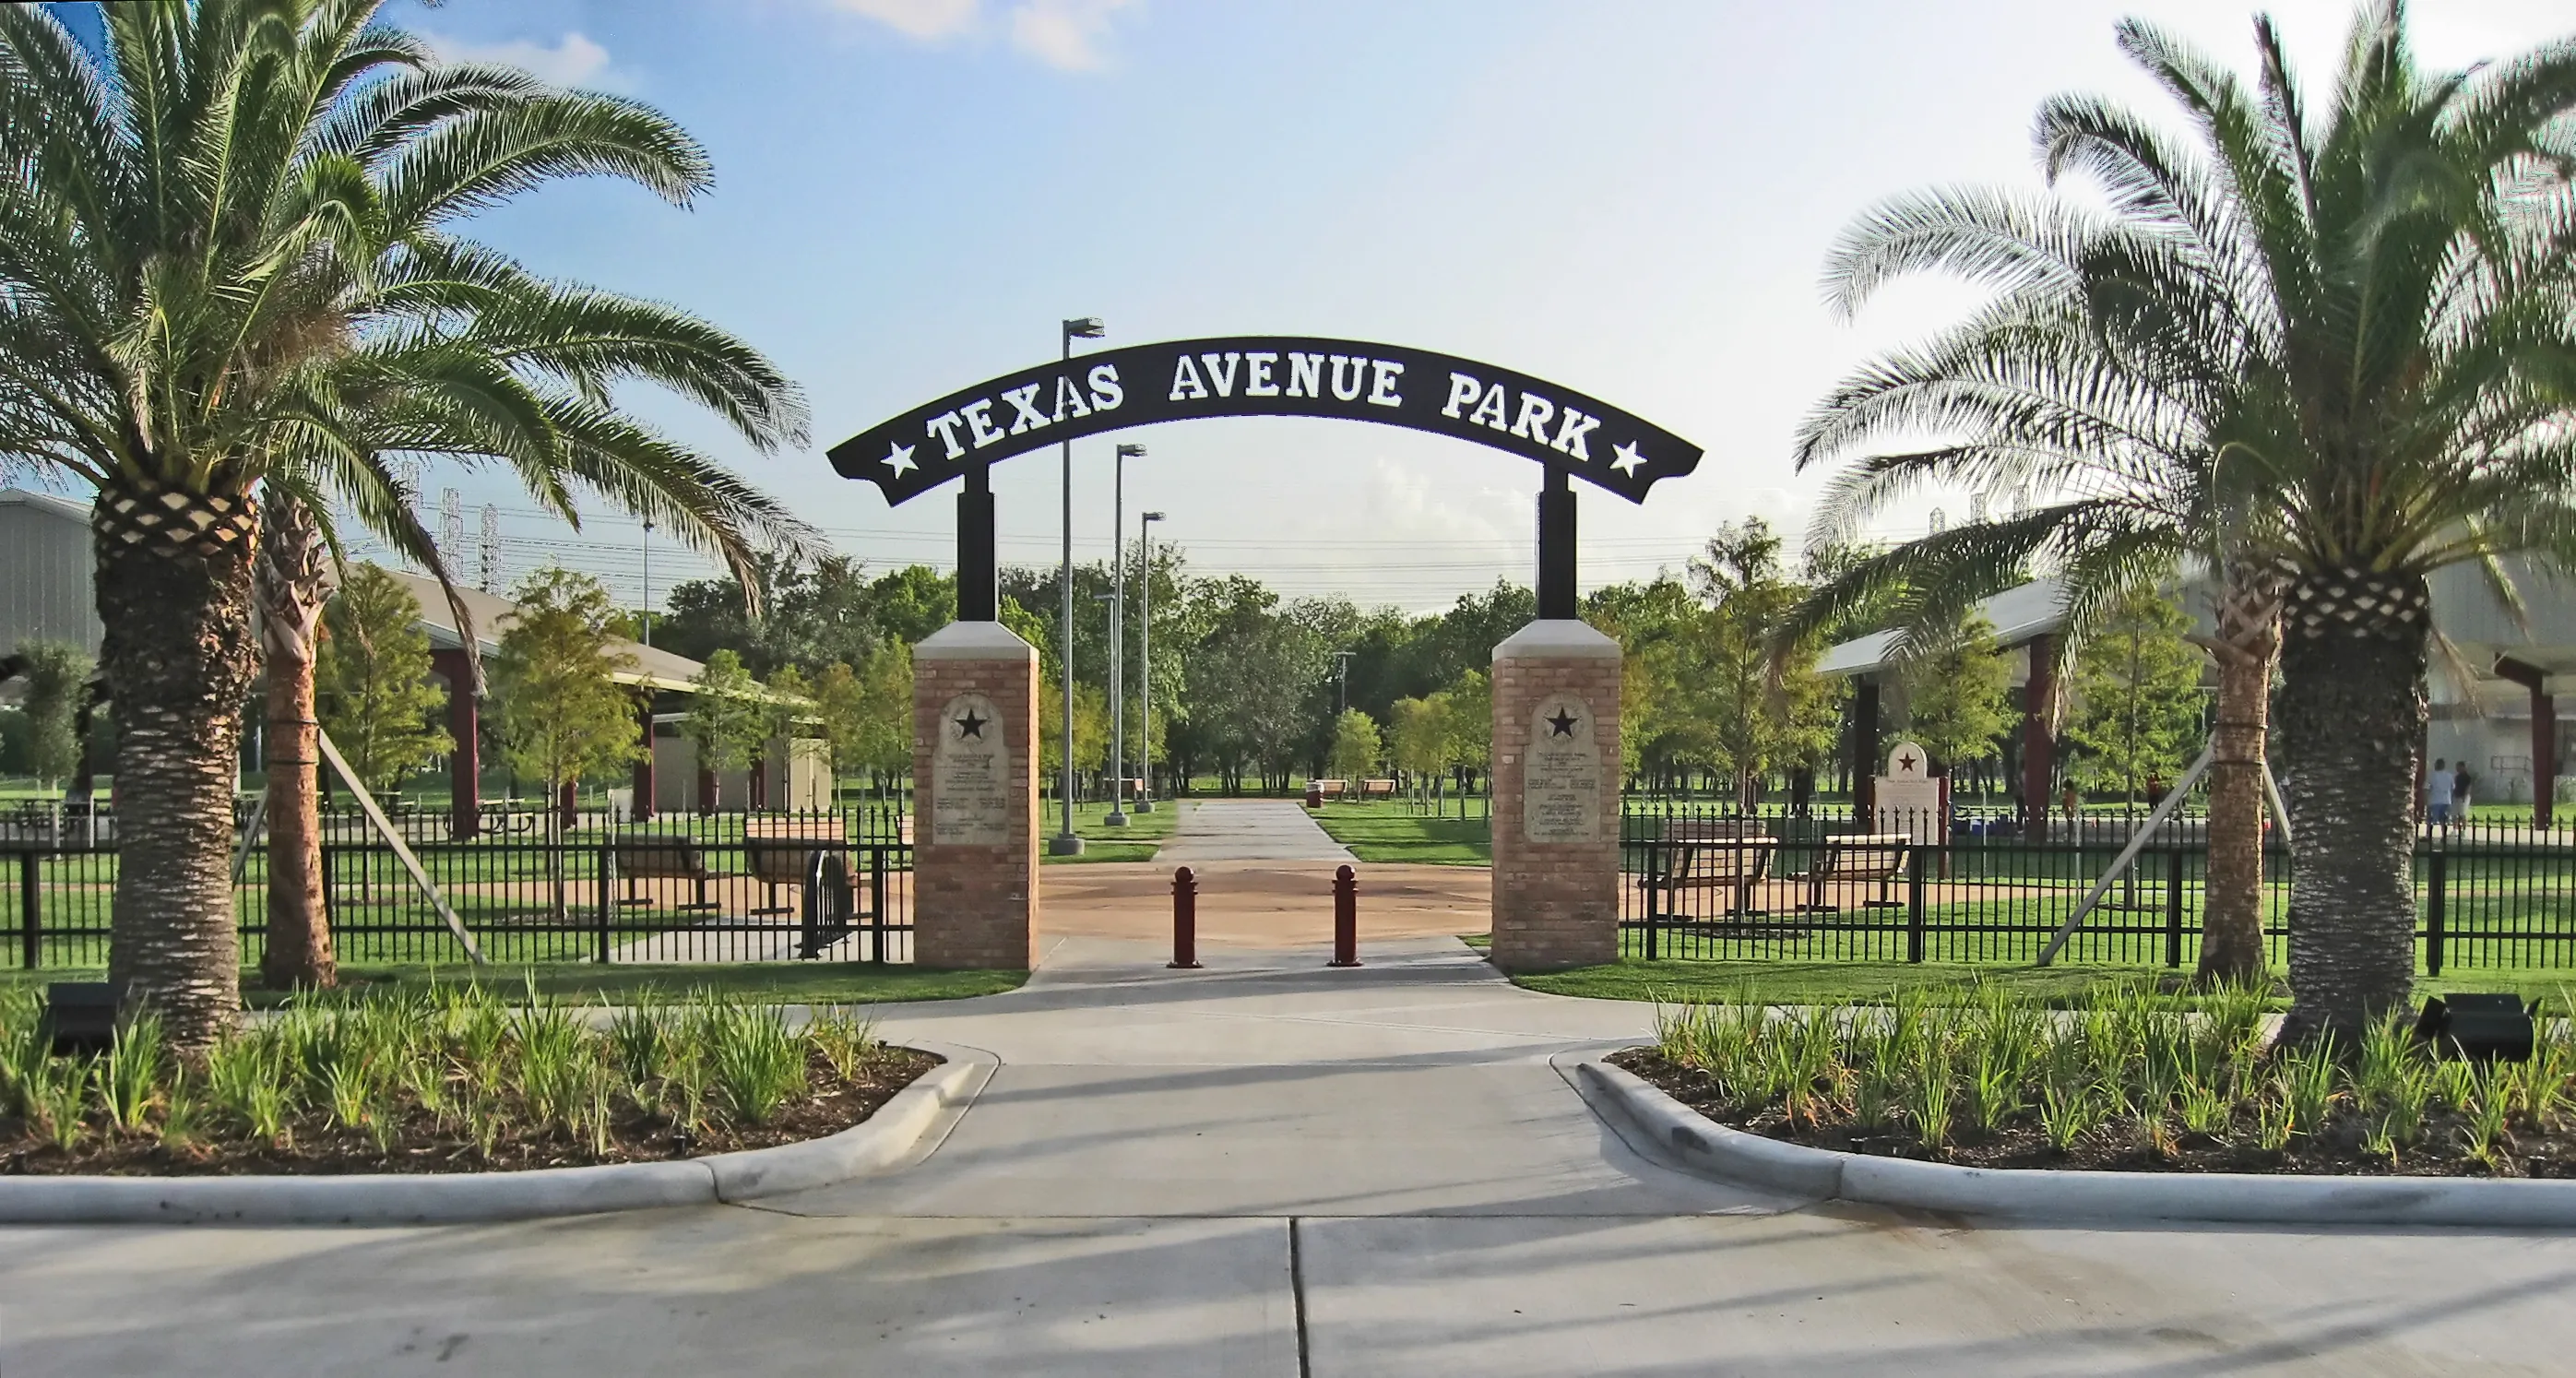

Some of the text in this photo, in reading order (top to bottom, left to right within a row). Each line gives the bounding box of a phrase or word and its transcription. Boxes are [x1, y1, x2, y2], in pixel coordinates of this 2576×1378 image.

[925, 351, 1601, 462] TEXAS AVENUE PARK
